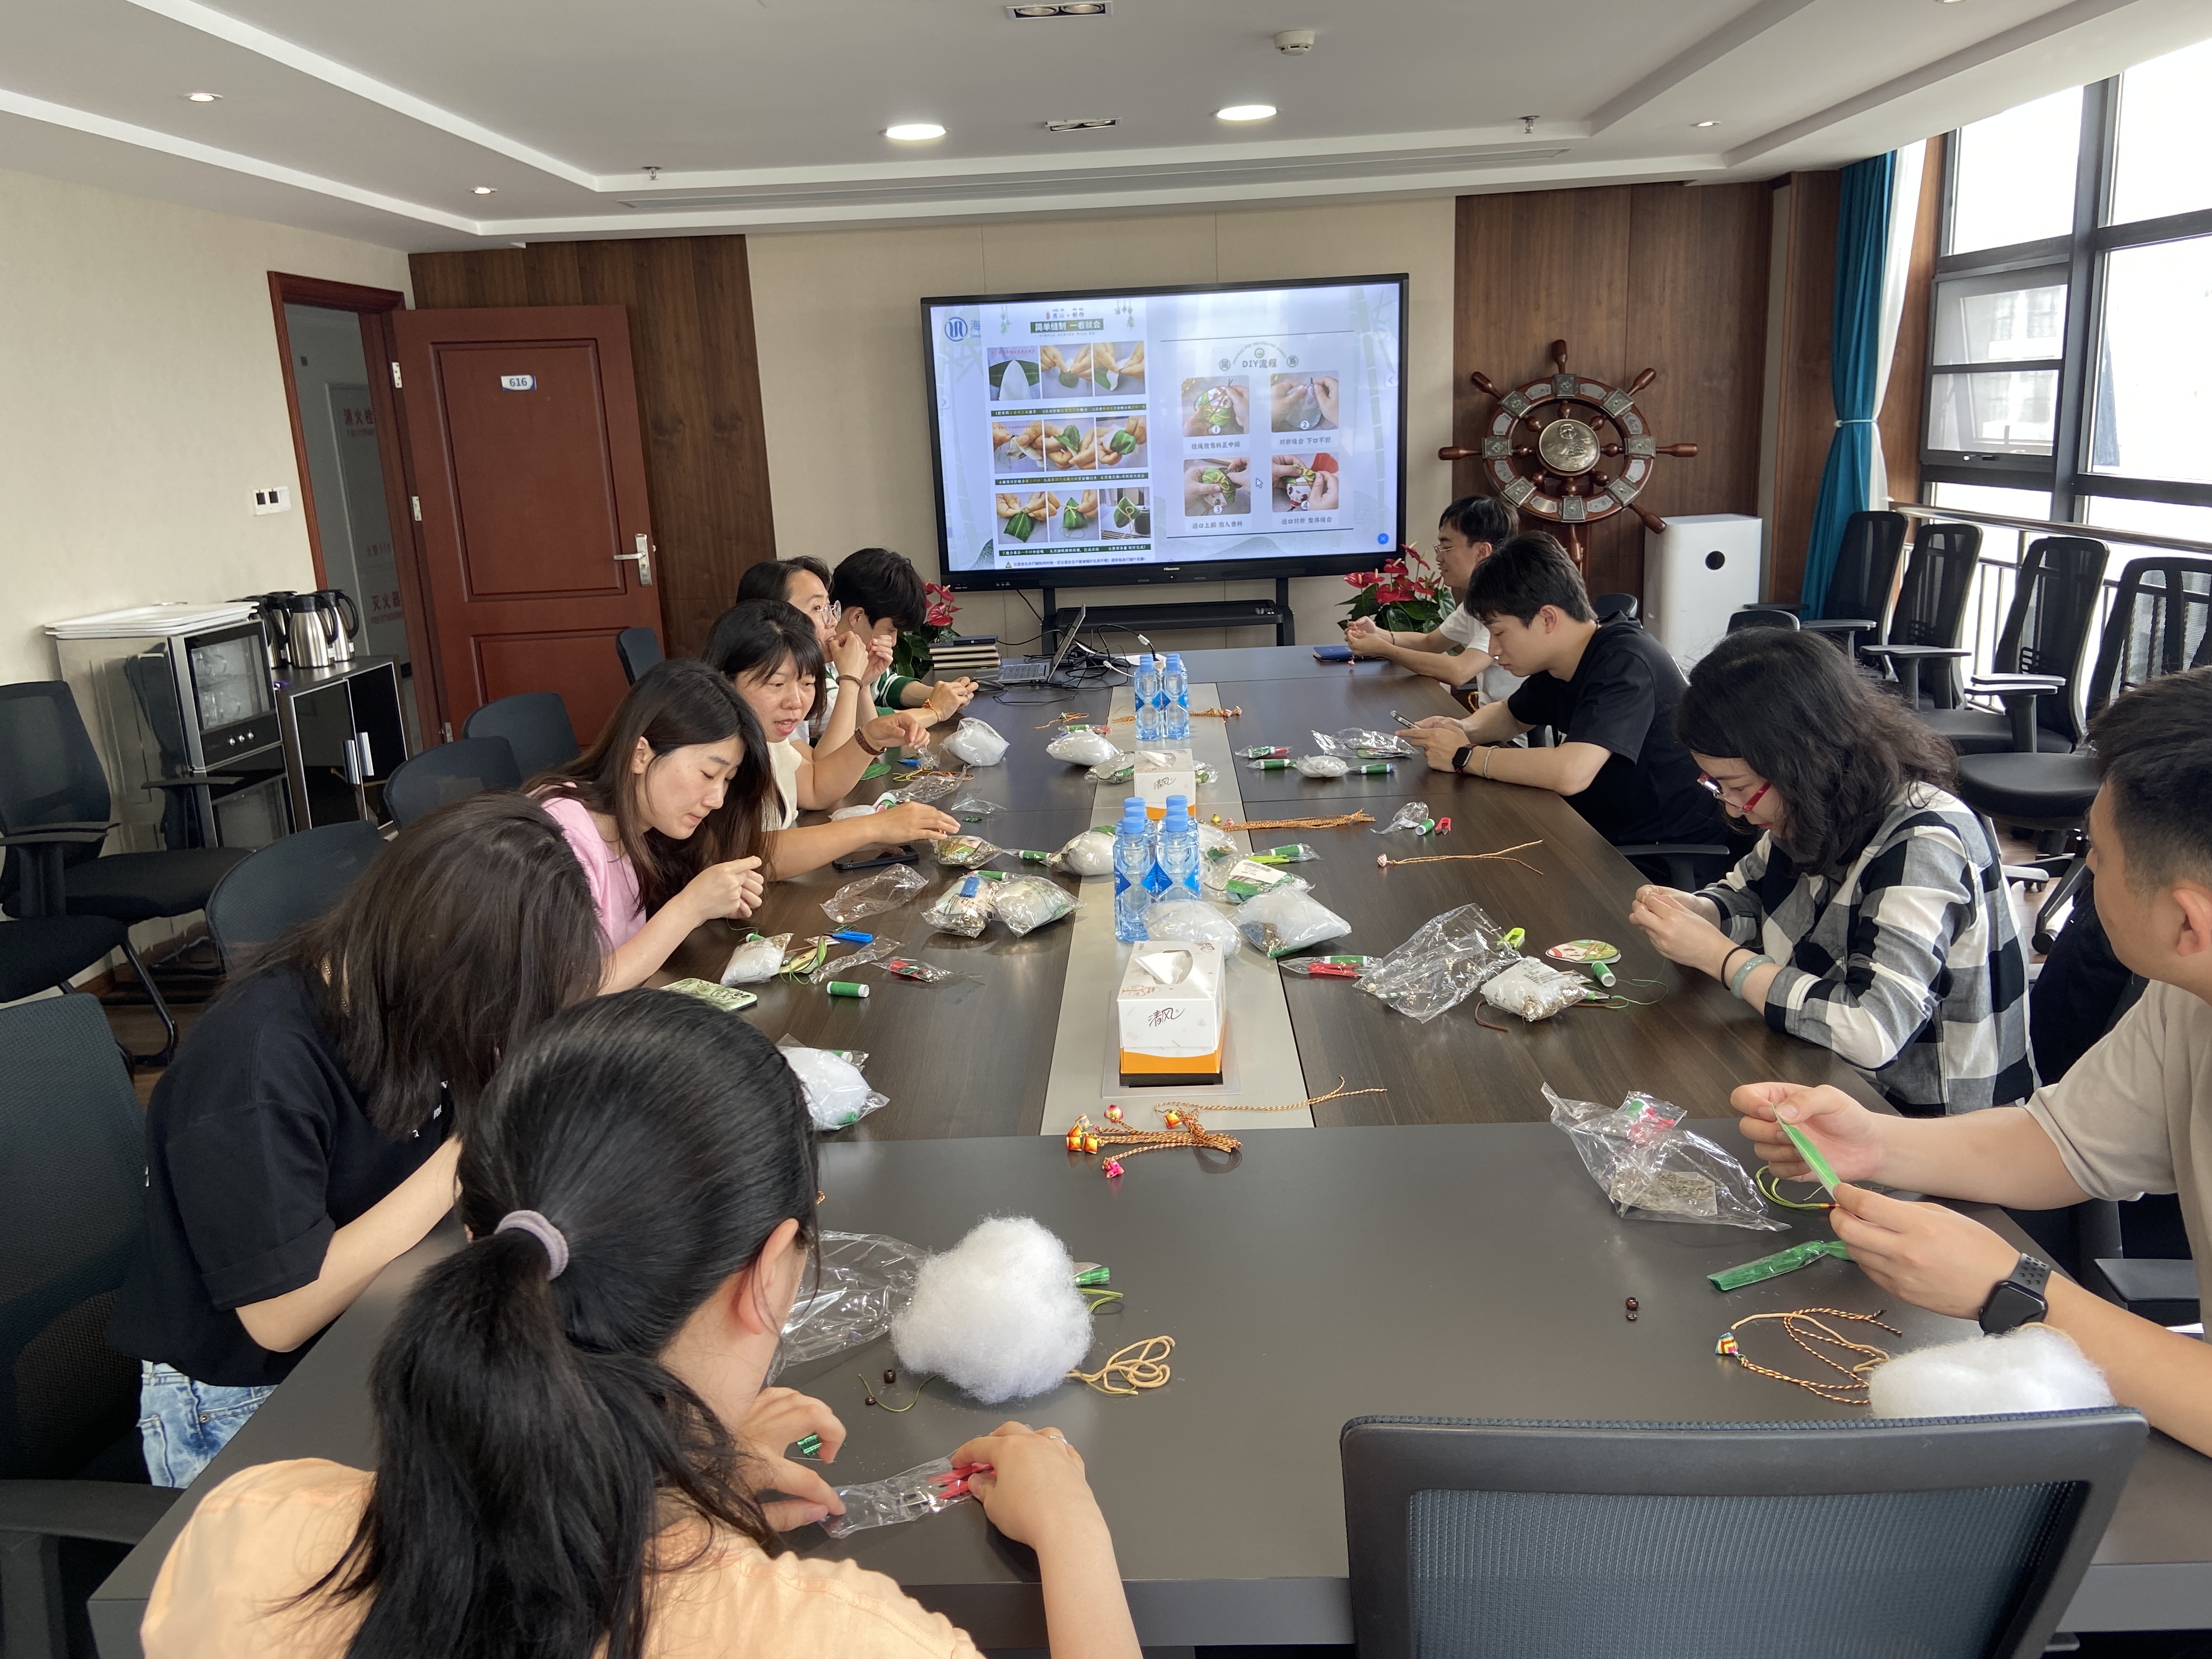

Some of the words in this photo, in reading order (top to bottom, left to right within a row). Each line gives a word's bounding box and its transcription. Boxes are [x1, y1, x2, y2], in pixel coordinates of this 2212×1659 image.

[1035, 322, 1066, 331] 简单缝制
[1069, 320, 1101, 330] 一看就会
[1243, 358, 1277, 368] DIY流程
[510, 377, 527, 387] 616
[1153, 777, 1176, 790] 清风
[1148, 1007, 1185, 1027] 清风
